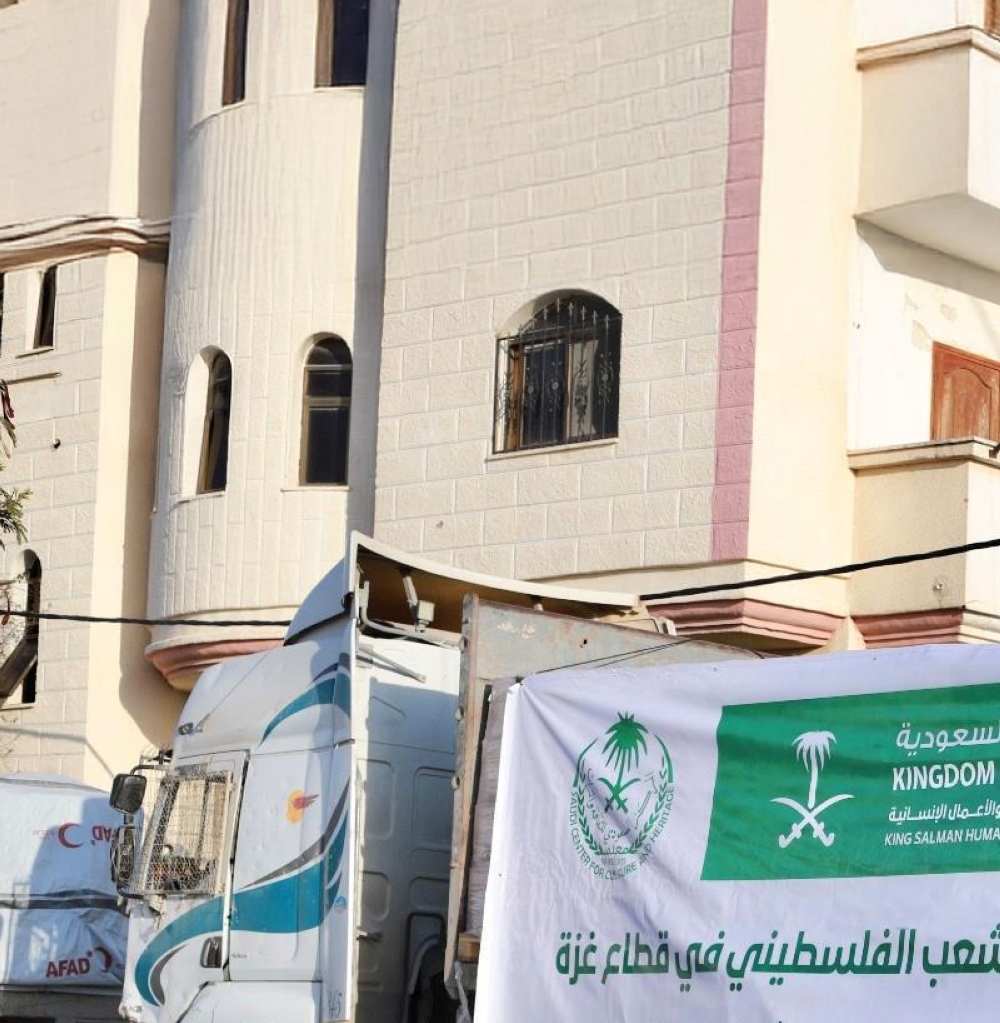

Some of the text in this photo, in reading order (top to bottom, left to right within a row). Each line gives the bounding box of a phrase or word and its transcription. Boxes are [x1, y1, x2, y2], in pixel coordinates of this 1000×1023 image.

[892, 760, 995, 791] KINGDOM
[888, 803, 948, 825] الإنسانية
[884, 832, 912, 846] KING
[913, 829, 963, 845] SALMAN
[45, 957, 91, 979] AFAD
[555, 930, 596, 985] غزة
[600, 930, 670, 985] قطاع
[674, 930, 725, 992] في
[726, 928, 916, 992] الفلسطيني
